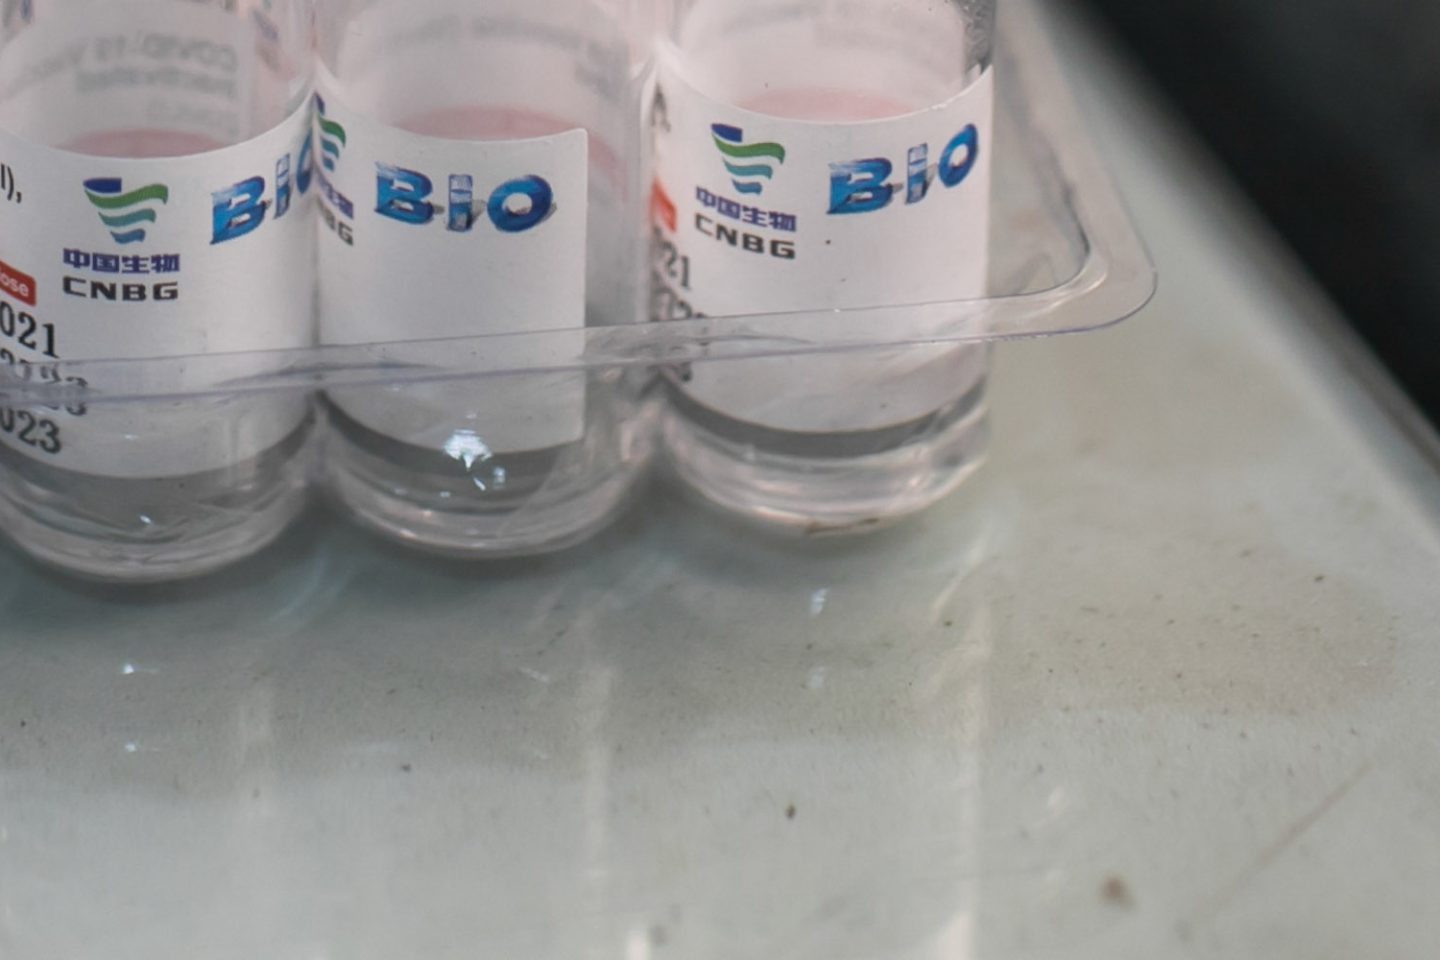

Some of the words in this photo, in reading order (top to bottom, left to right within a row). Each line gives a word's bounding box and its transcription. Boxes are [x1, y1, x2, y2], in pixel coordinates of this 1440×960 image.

[696, 186, 797, 232] 中国生物
[695, 213, 797, 261] CNBG
[63, 248, 181, 274] 中国生物
[63, 275, 179, 301] CNBG
